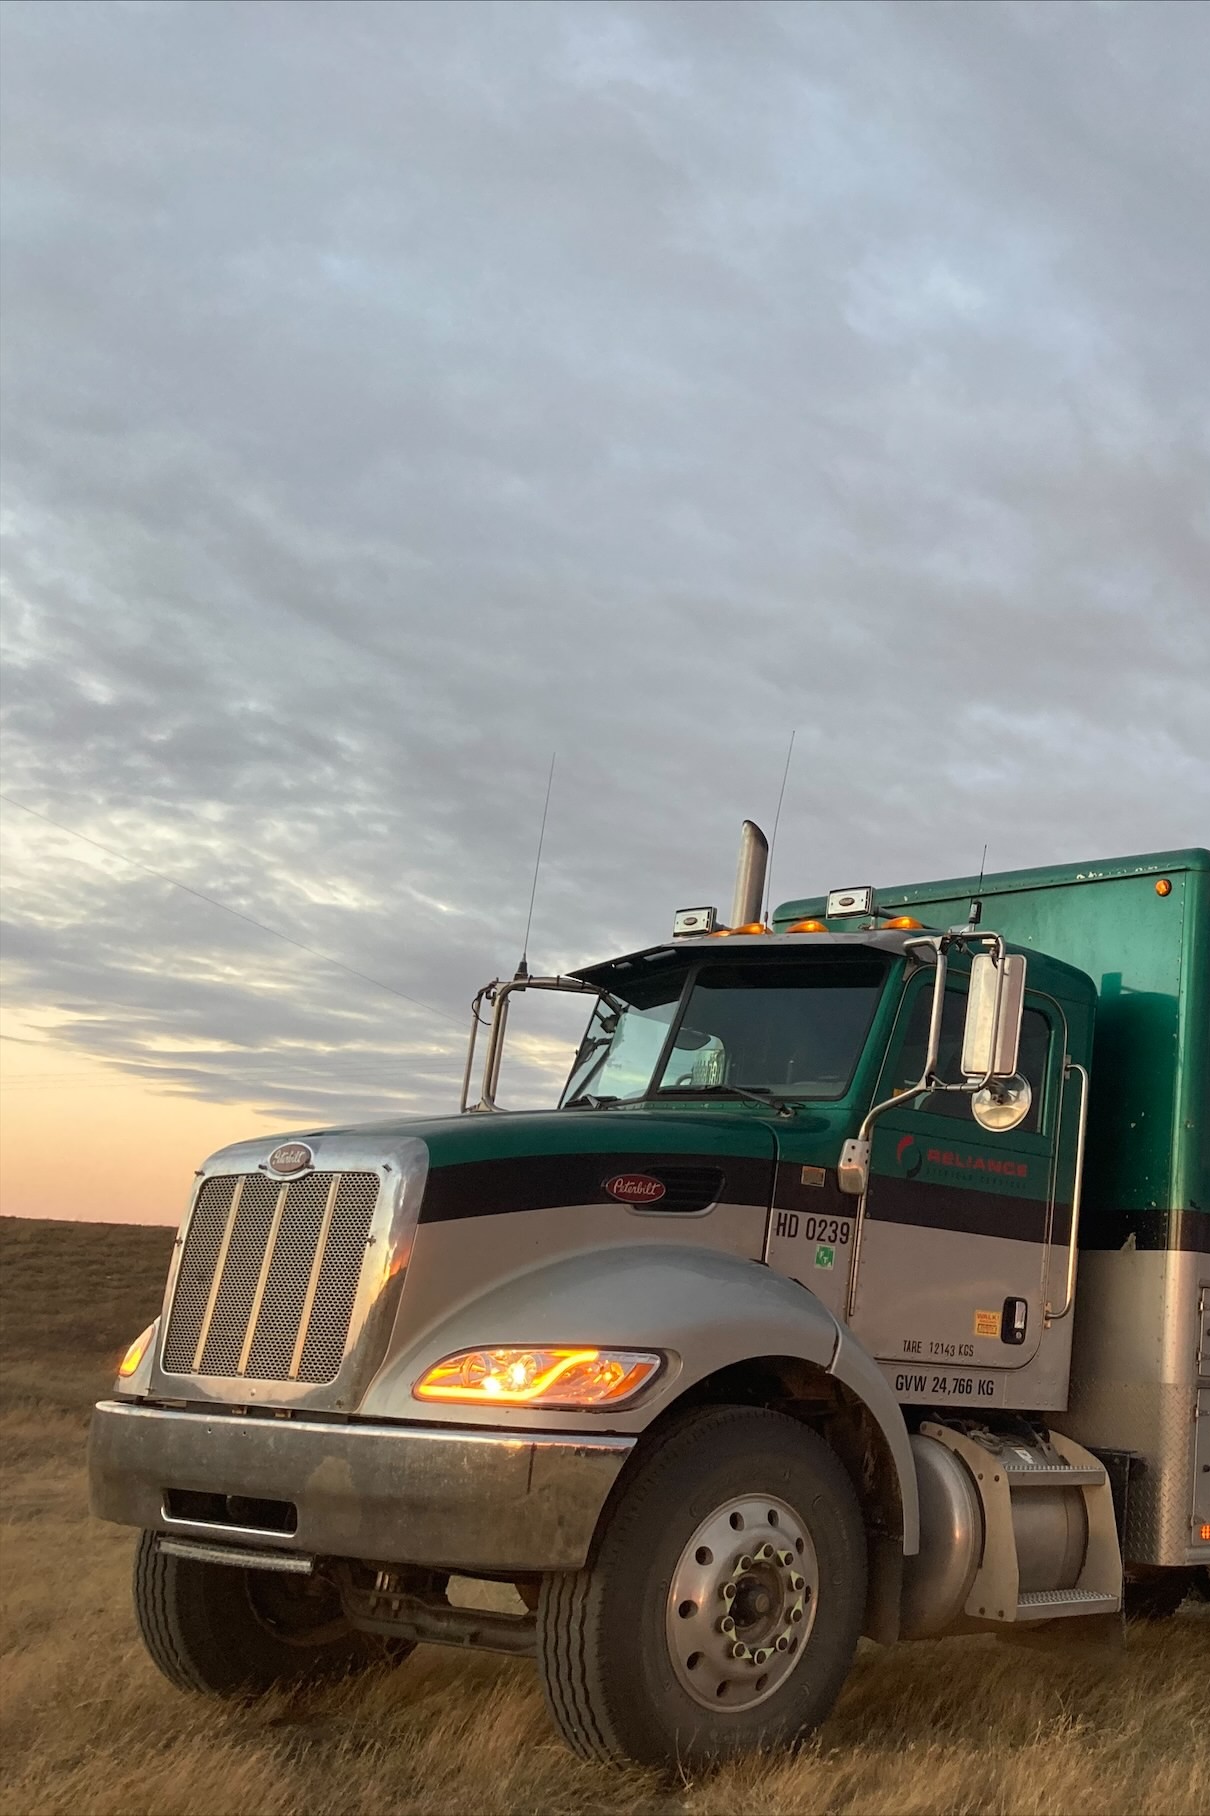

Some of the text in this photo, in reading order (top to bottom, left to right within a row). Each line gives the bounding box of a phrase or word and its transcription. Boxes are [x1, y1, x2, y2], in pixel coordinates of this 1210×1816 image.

[927, 1148, 1028, 1177] RELIANCE
[613, 1178, 661, 1196] Peterbilt
[776, 1212, 850, 1245] HD 0239
[903, 1340, 974, 1357] TARE 12143 KGS
[895, 1374, 994, 1396] GVW 24,766 KG
